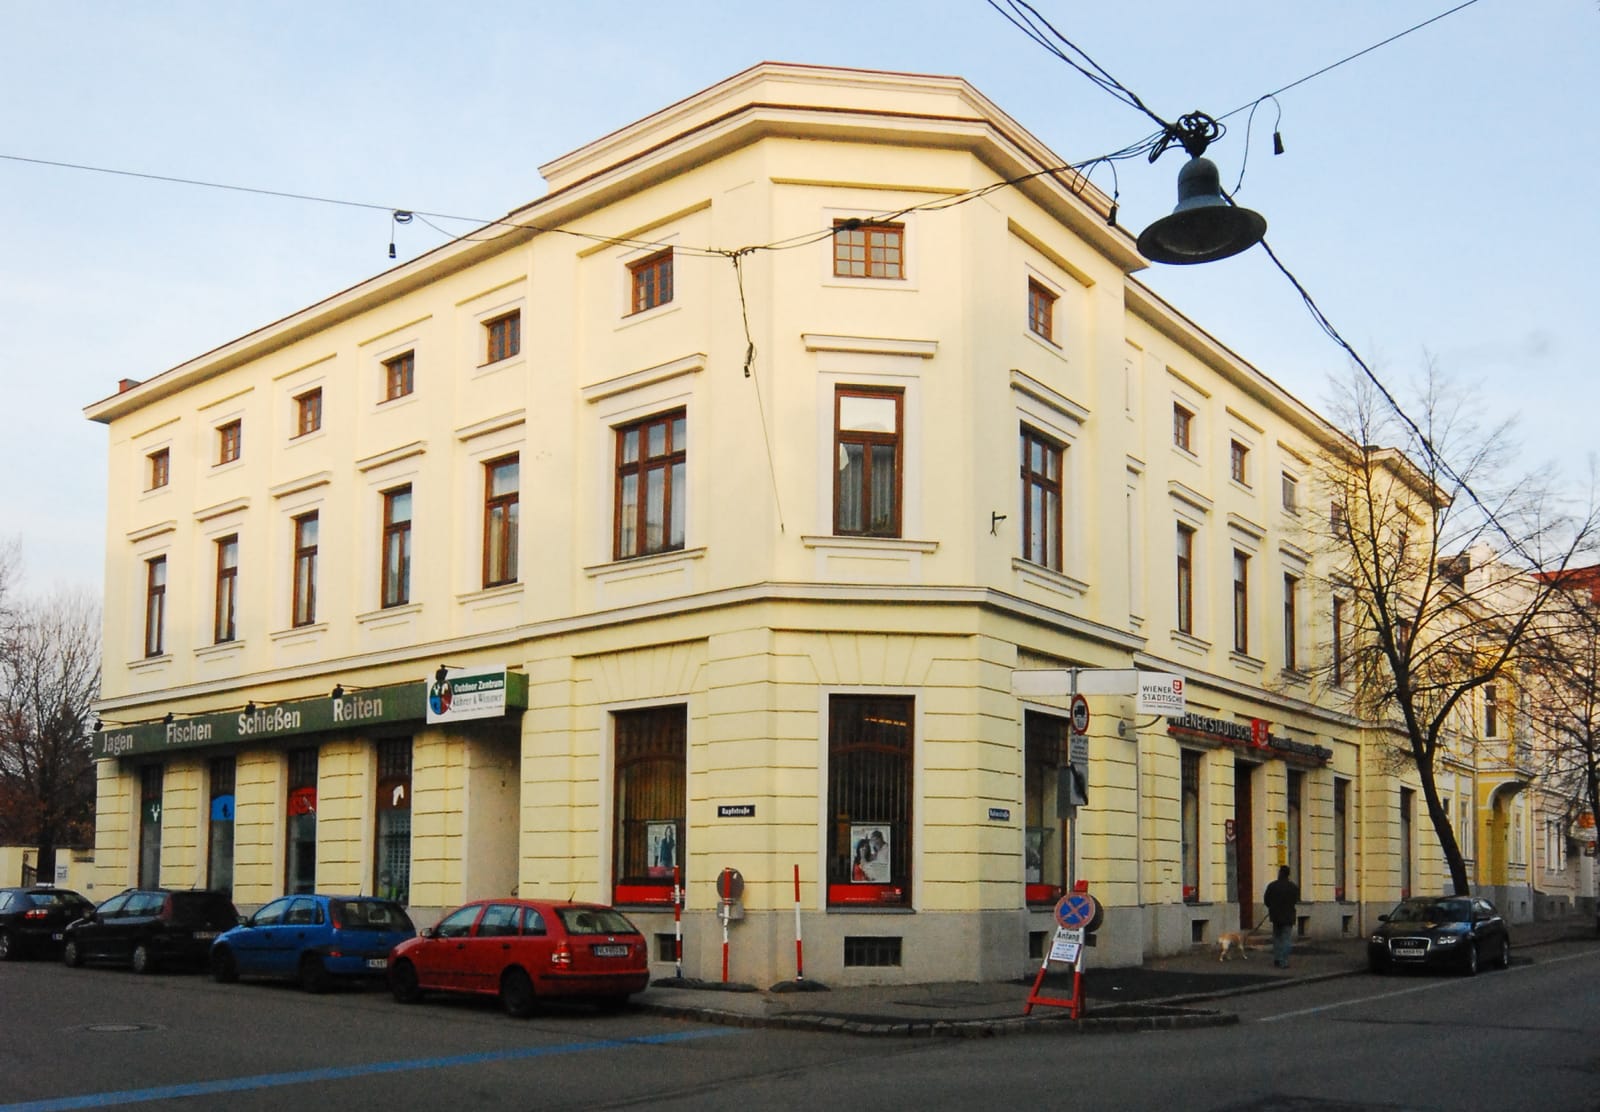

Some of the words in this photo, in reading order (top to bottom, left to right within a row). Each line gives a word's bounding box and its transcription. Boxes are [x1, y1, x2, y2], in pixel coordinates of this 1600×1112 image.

[454, 682, 477, 693] Outdoor
[478, 680, 504, 690] Zentrum
[1142, 685, 1172, 693] WIENER
[333, 697, 382, 722] Reiten
[238, 707, 301, 735] Schießen
[1175, 711, 1208, 731] WIENER
[166, 721, 212, 743] Fischen
[102, 733, 133, 756] Jagen
[1058, 931, 1080, 941] Anfang
